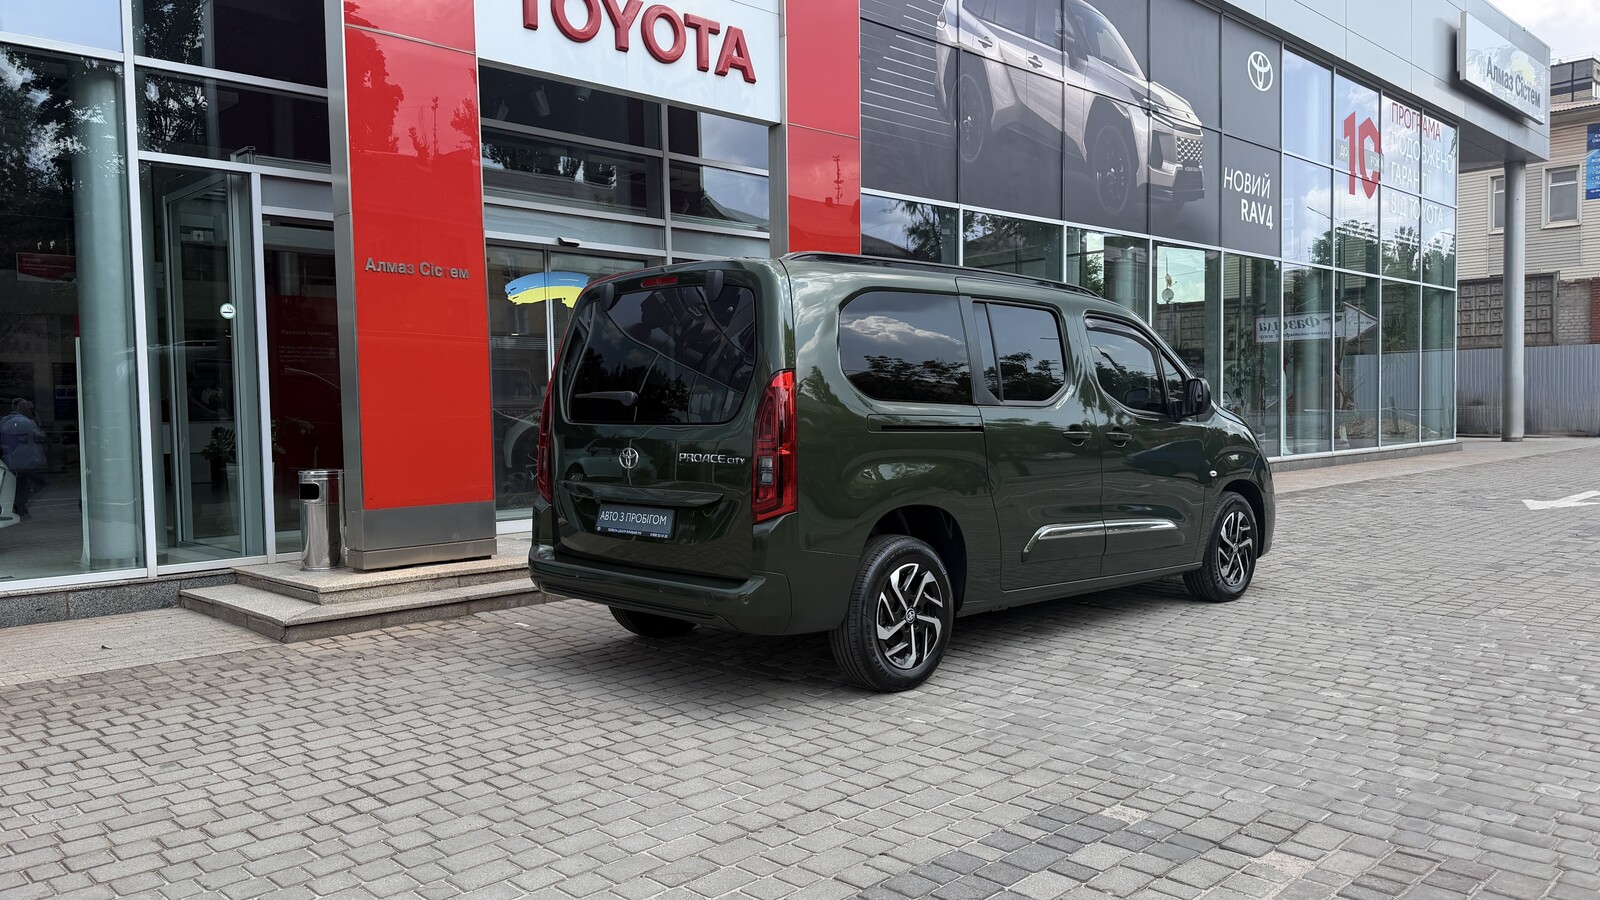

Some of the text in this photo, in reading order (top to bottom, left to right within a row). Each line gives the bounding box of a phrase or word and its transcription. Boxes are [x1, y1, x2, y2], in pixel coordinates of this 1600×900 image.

[1487, 56, 1541, 108] Алмаз Сістем
[1391, 102, 1441, 142] ПРОГРАМА
[1223, 166, 1270, 199] НОВИЙ
[1241, 198, 1273, 230] RAV4
[365, 257, 415, 275] Алмаз
[679, 452, 746, 465] PROACE CITY
[600, 511, 668, 526] АВТО З ПРОБІГОМ
